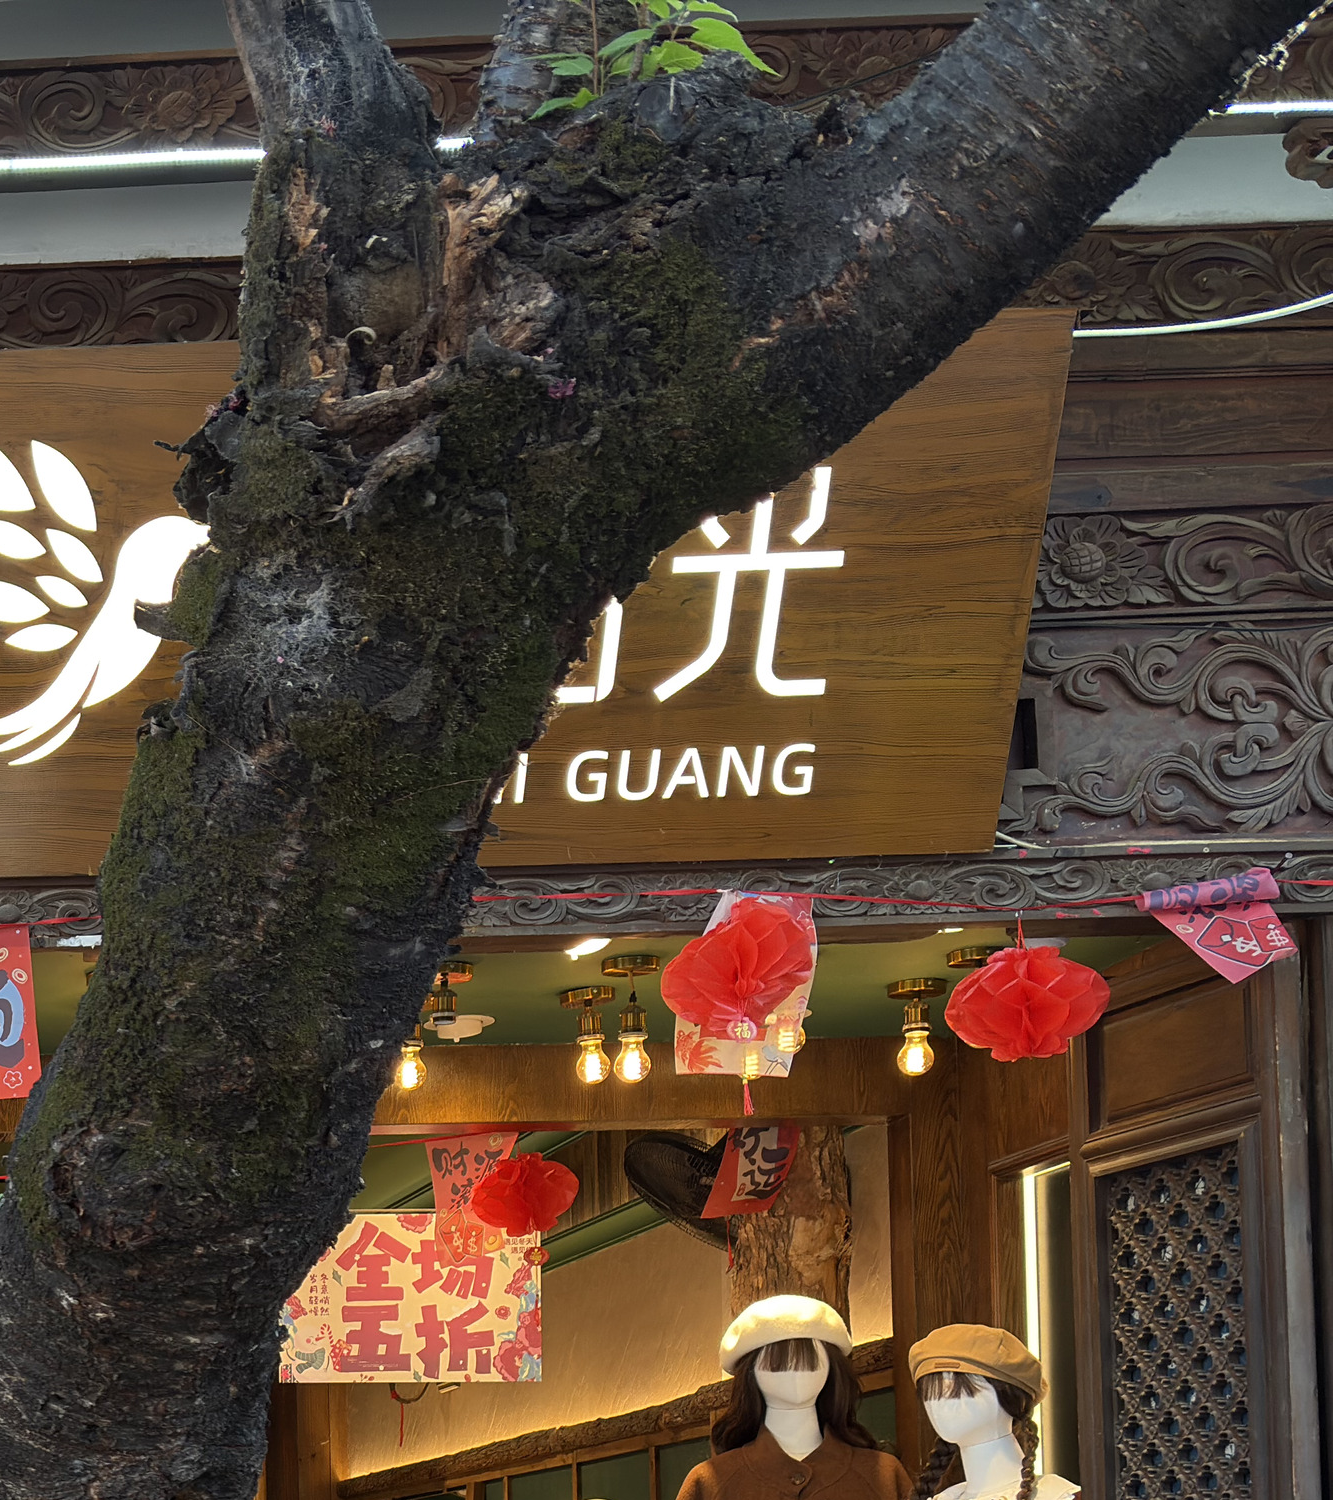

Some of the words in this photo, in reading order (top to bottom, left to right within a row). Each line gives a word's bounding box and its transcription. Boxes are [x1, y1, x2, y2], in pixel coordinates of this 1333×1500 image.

[555, 464, 846, 704] 光
[566, 743, 817, 803] GUANG
[734, 1022, 752, 1040] 福
[335, 1221, 494, 1302] 全场
[341, 1300, 495, 1379] 五折
